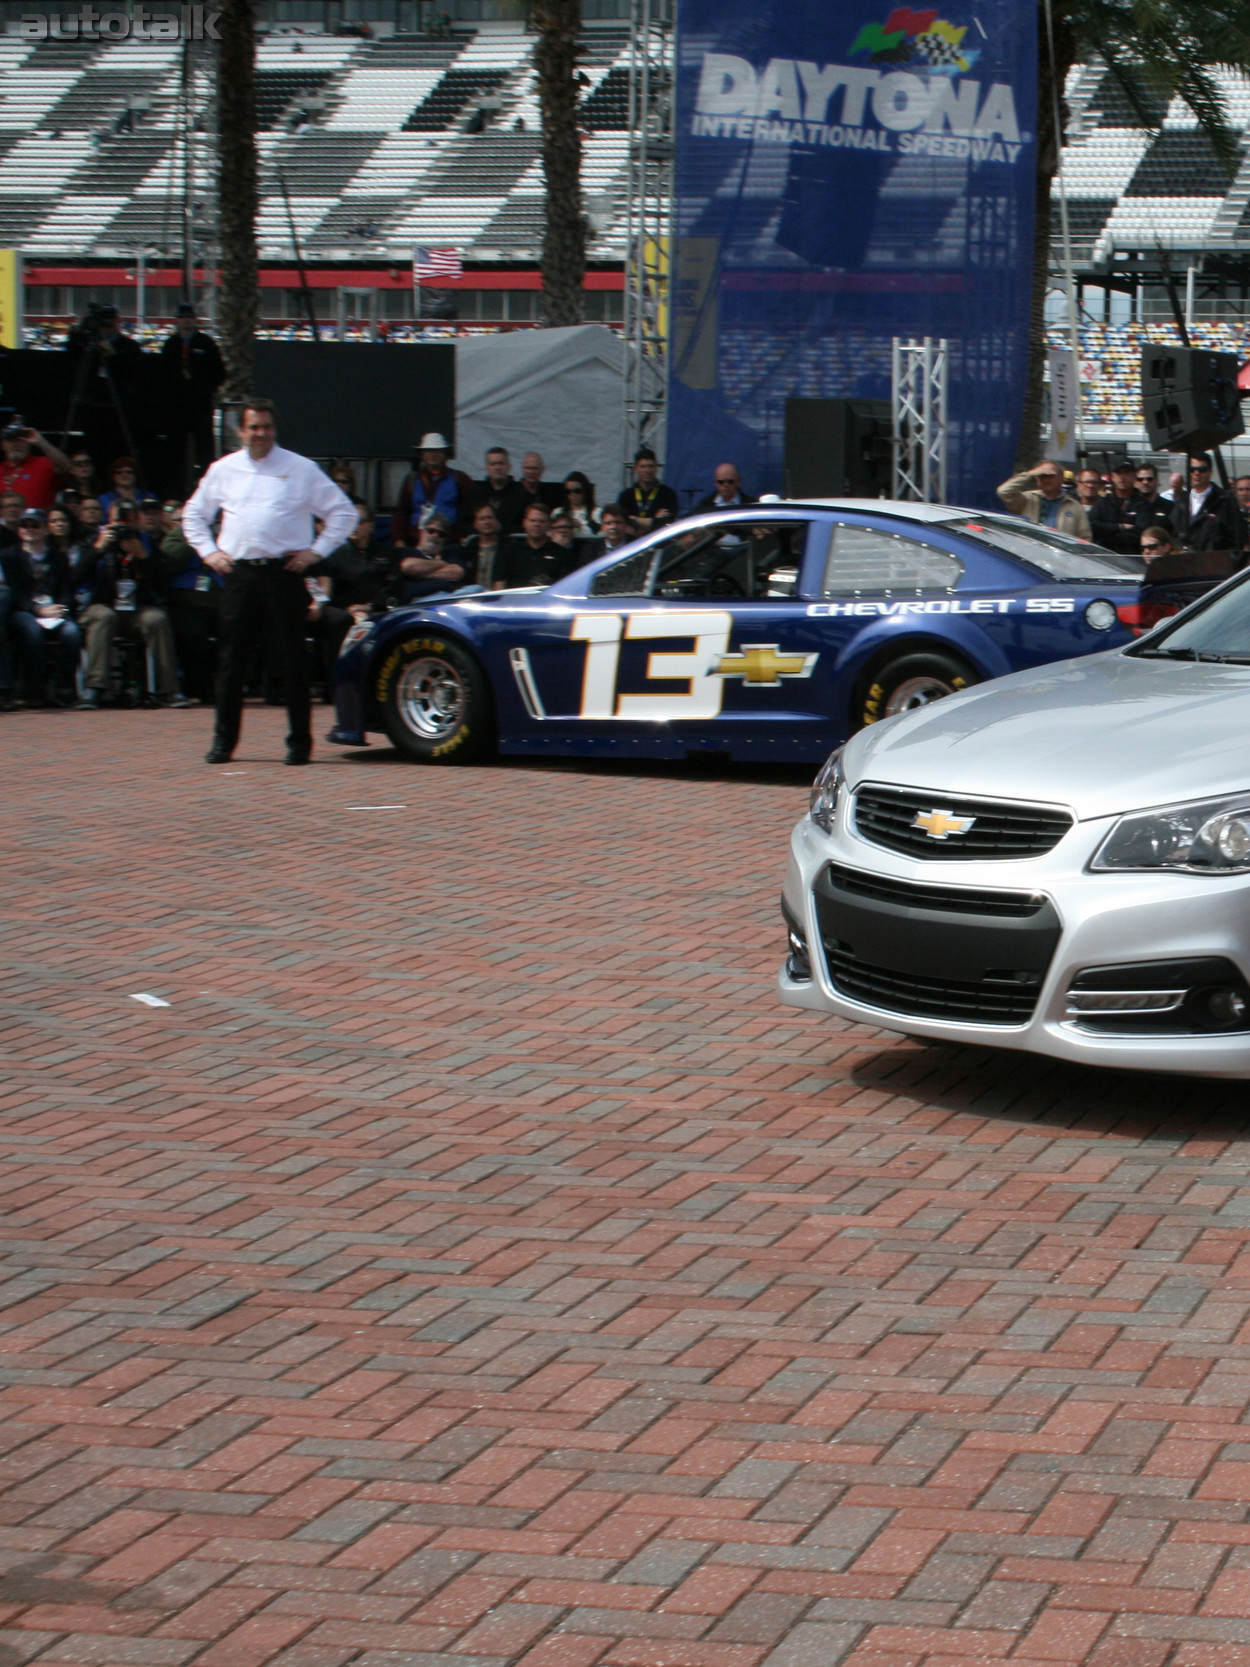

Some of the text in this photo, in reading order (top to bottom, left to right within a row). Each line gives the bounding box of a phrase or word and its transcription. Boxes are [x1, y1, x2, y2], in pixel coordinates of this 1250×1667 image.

[695, 52, 1021, 143] DAYTONA
[691, 115, 1023, 164] INTERNATIONAL SPEEDWAY
[806, 598, 1075, 617] CHEVROLET SS
[569, 611, 733, 720] 13
